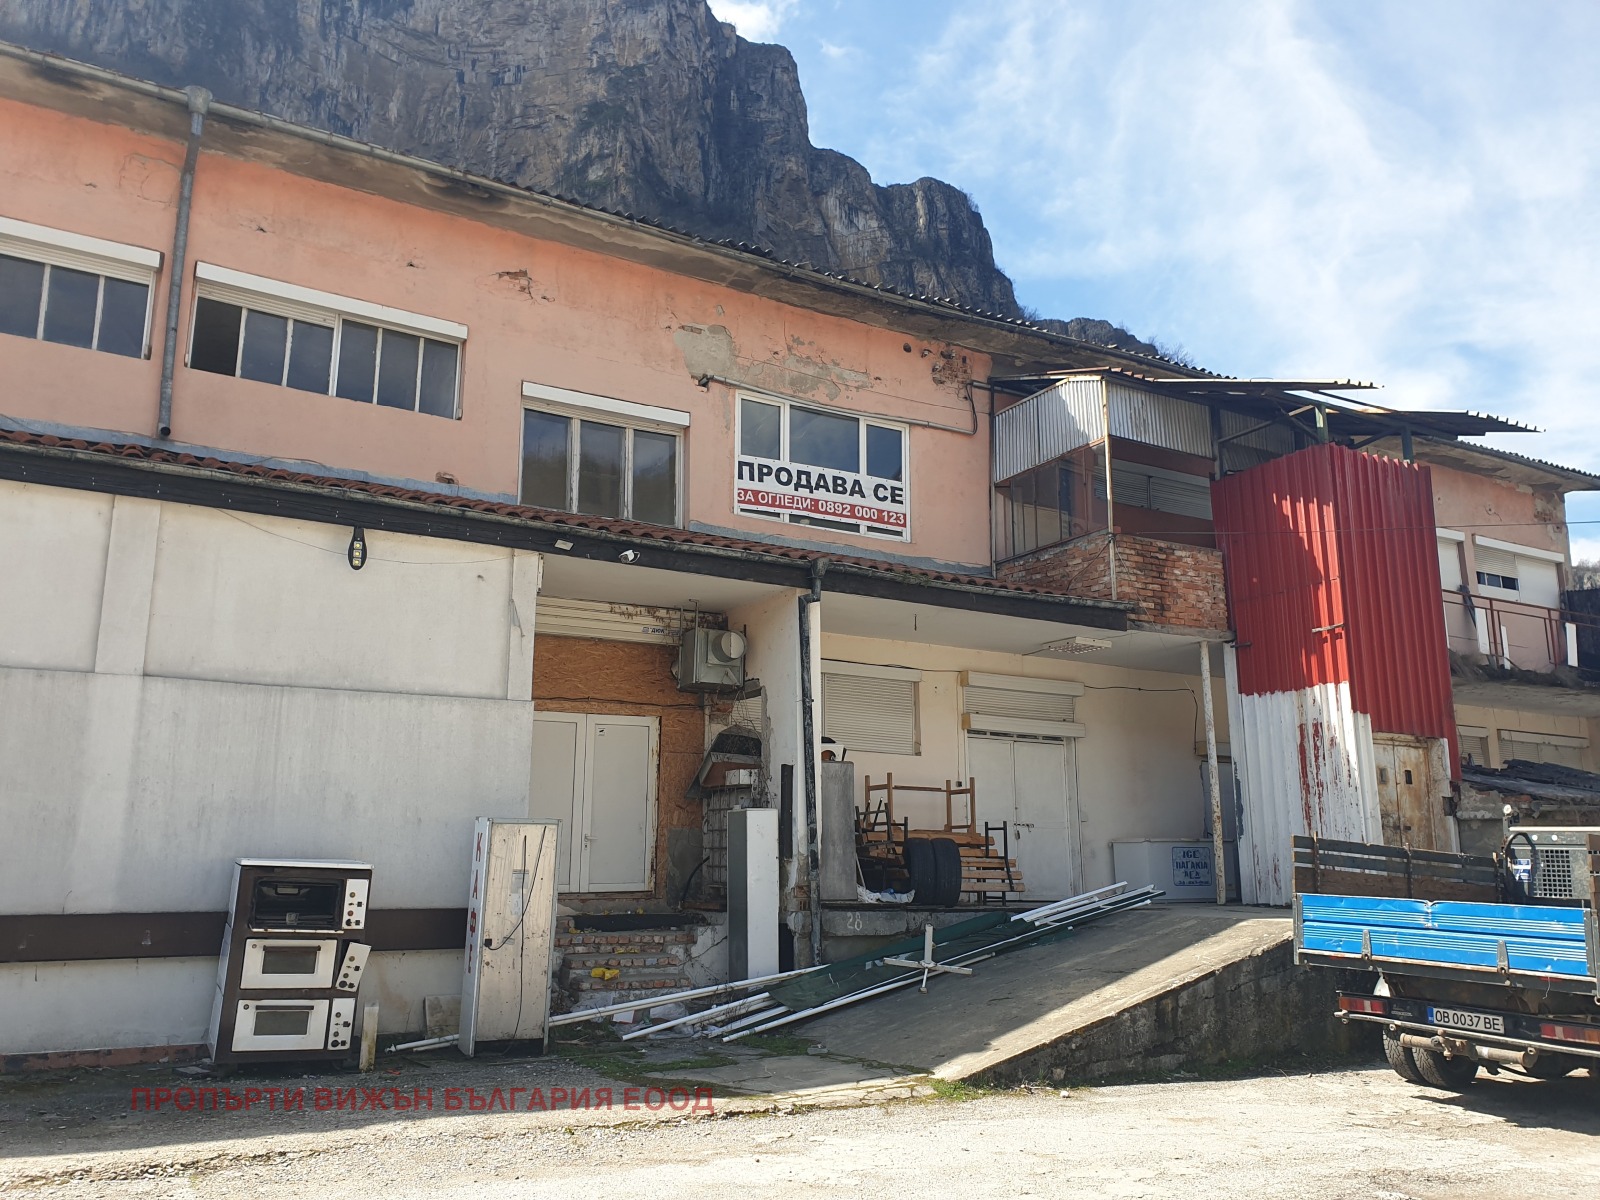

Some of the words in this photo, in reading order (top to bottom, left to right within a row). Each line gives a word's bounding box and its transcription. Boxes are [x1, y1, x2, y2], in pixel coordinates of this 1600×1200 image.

[738, 460, 866, 499] ПРОДАВА
[873, 483, 904, 505] СЕ
[738, 489, 755, 503] ЗА
[758, 492, 814, 511] ОГЛЕДИ:
[818, 500, 851, 516] 0892
[855, 506, 878, 520] 000
[882, 511, 905, 525] 123
[846, 911, 862, 931] 28
[1452, 1012, 1481, 1028] 0037
